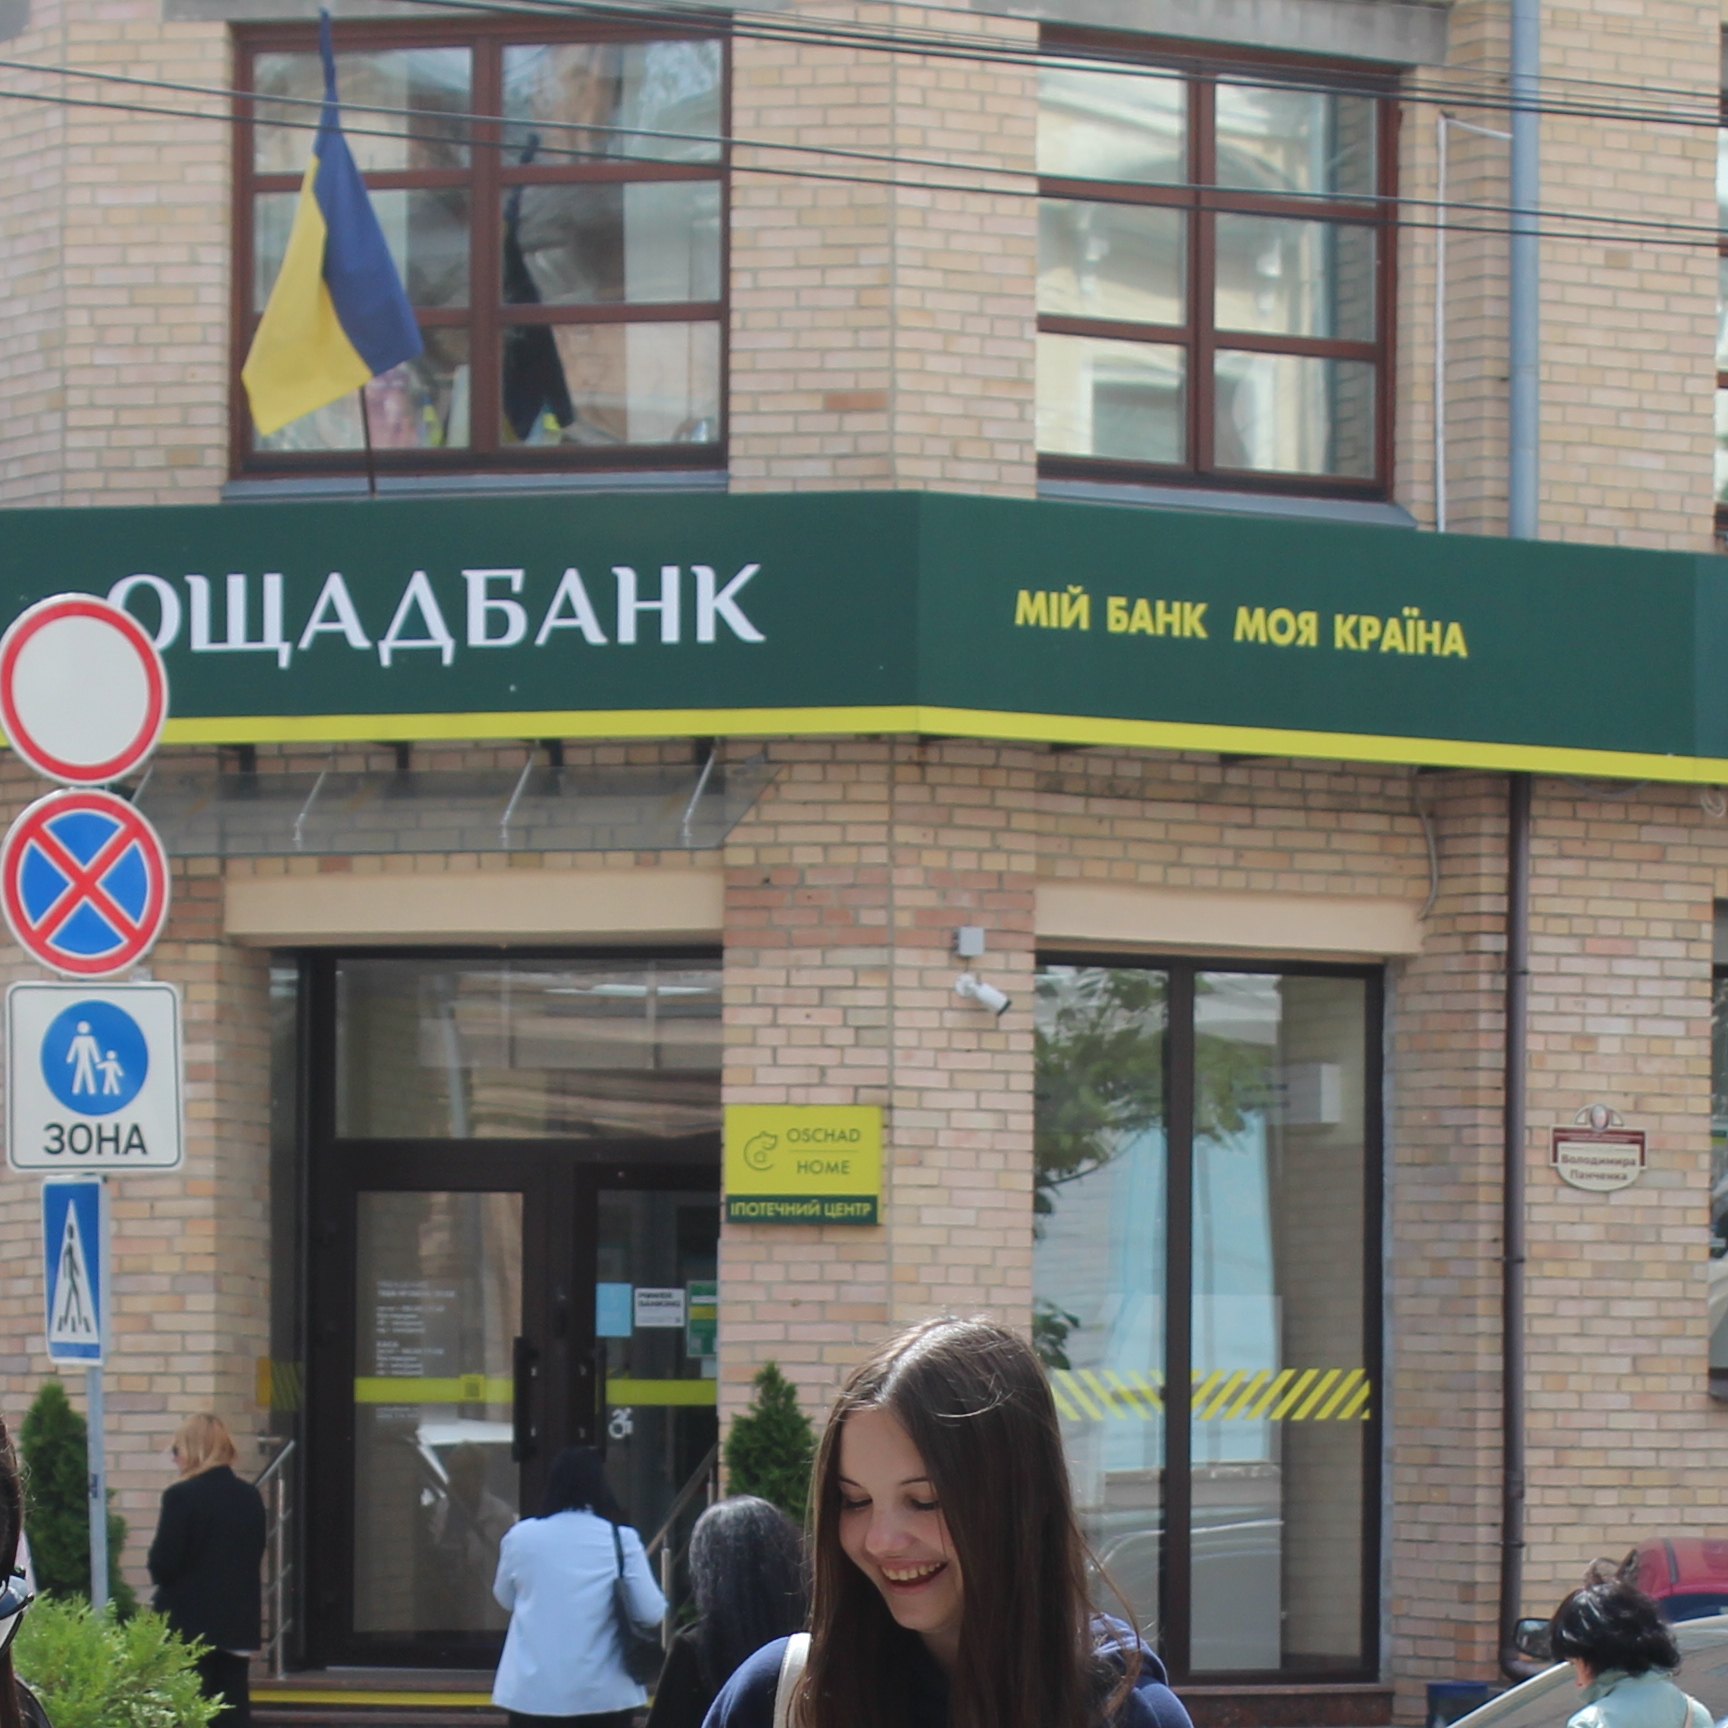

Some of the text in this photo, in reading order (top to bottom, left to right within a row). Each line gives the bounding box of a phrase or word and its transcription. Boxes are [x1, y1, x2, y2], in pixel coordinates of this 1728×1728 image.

[107, 563, 766, 670] ОЩАДБАНК
[1015, 585, 1469, 658] МІЙ БАНК МОЯ КРАЇНА
[42, 1121, 148, 1157] ЗОНА
[786, 1128, 861, 1143] OSCHAD
[797, 1160, 850, 1174] HOME
[730, 1199, 872, 1218] ІПОТЕЧНИЙ ЦЕНТР
